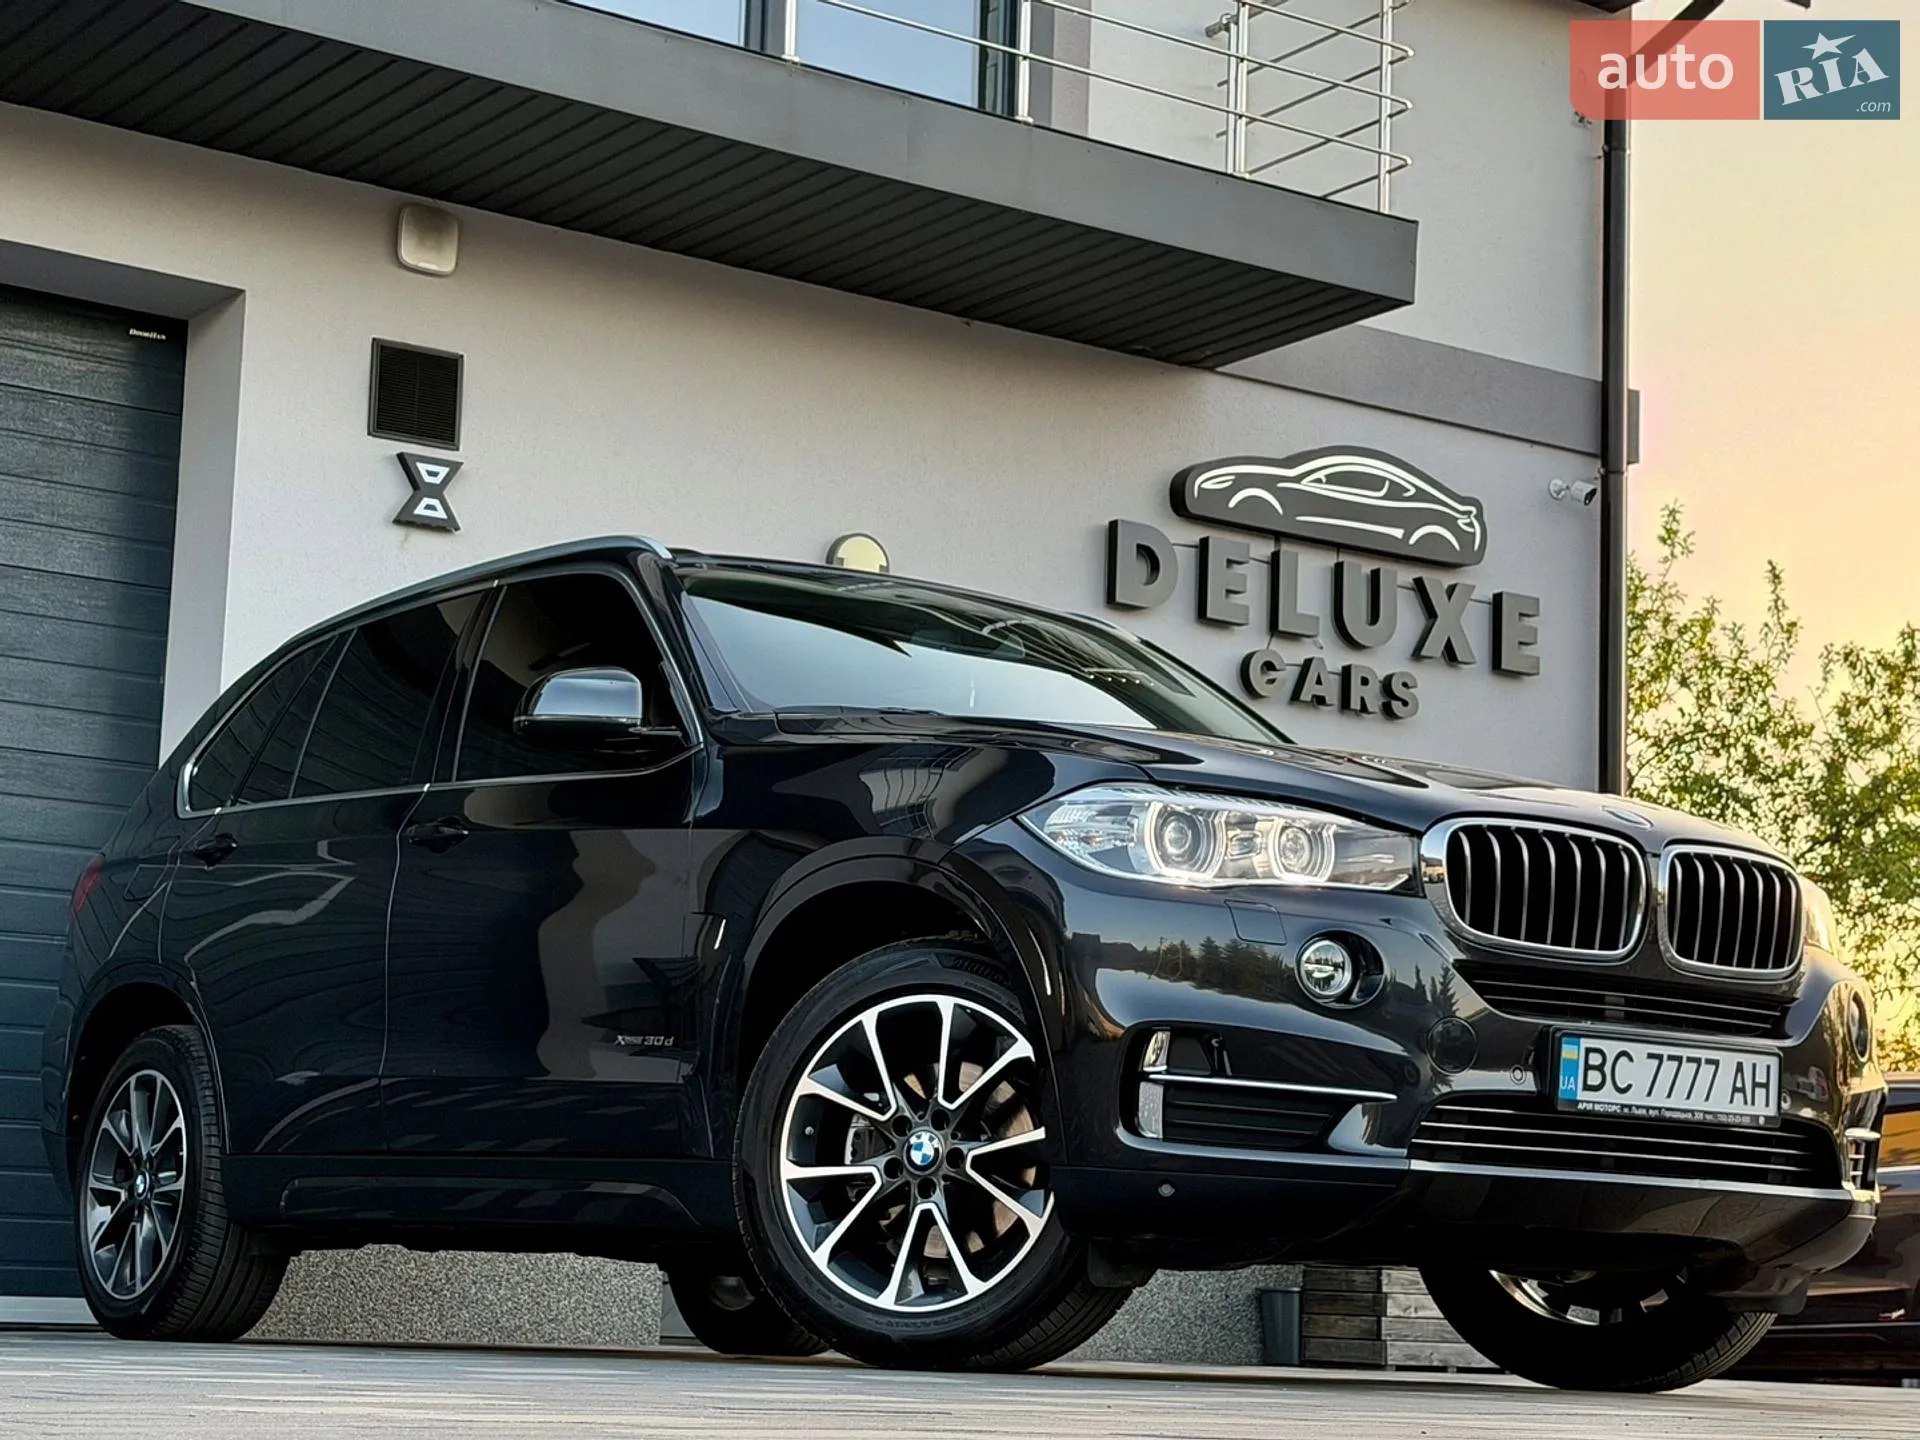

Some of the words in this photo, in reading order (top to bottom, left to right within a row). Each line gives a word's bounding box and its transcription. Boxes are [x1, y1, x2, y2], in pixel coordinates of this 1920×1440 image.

[1106, 519, 1541, 677] DELUXE
[1239, 649, 1420, 720] CARS
[1560, 1075, 1576, 1091] UA
[1582, 1046, 1635, 1095] BC
[1646, 1052, 1720, 1102] 7777
[1729, 1061, 1771, 1108] AH
